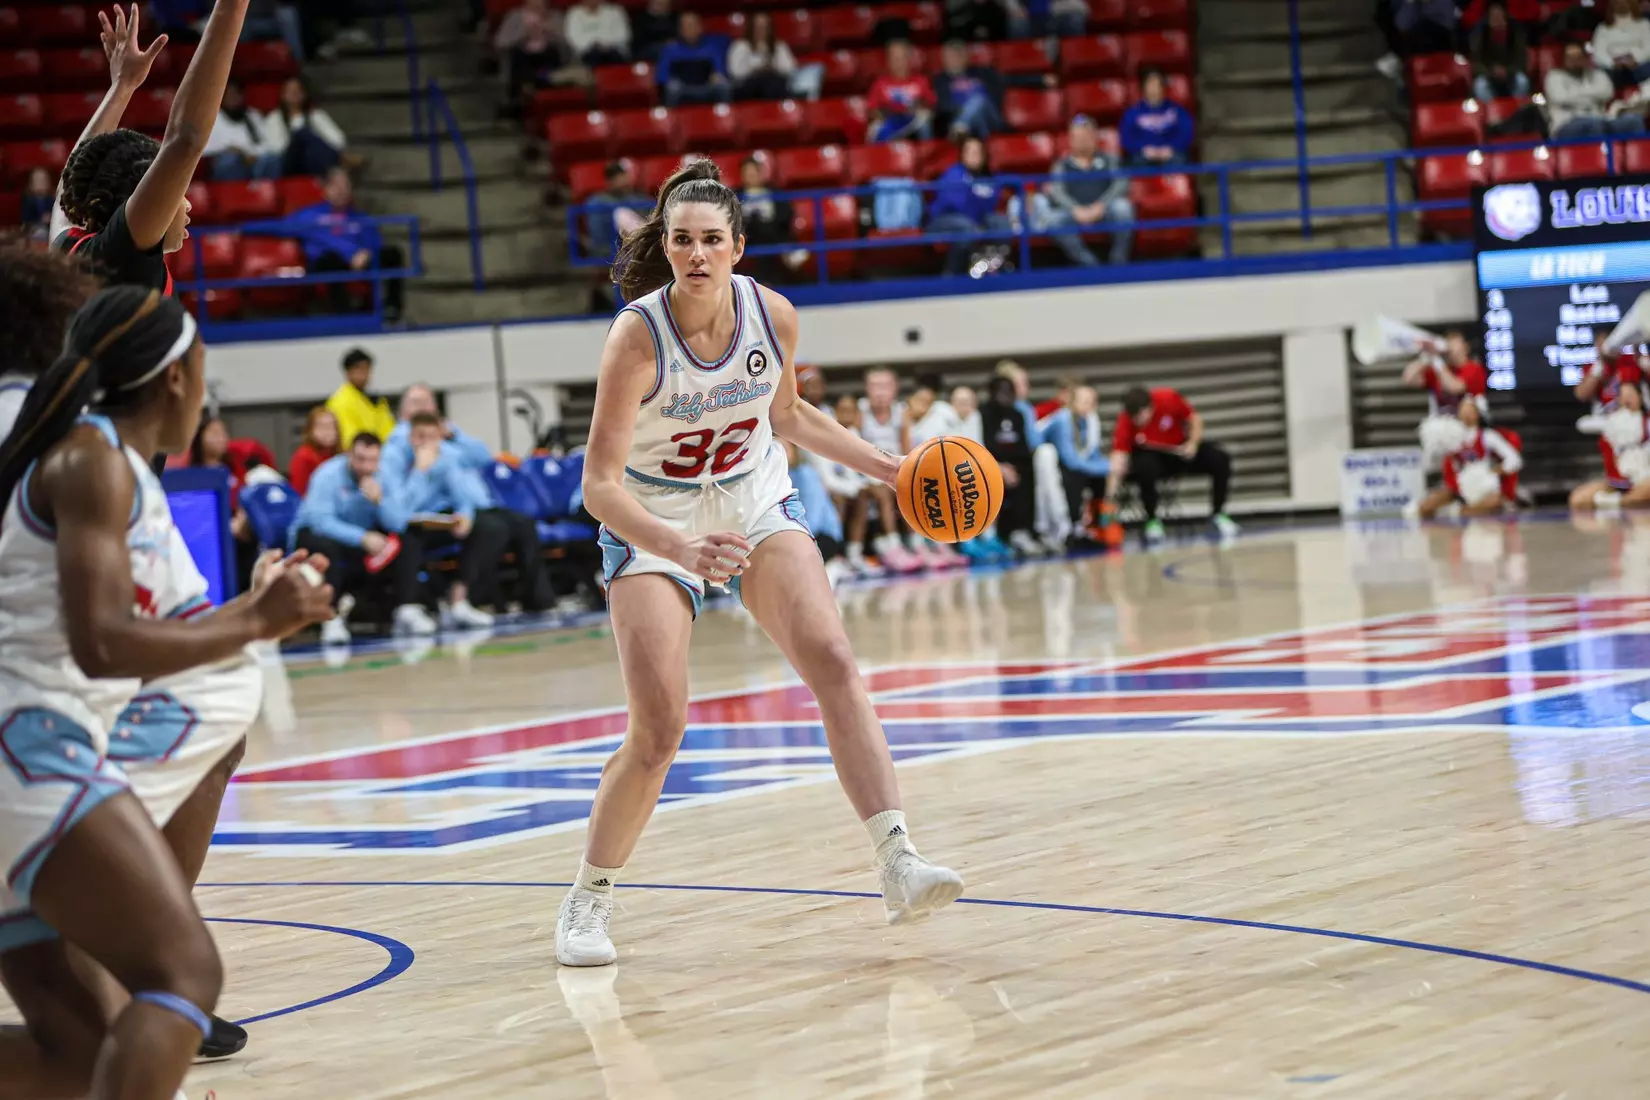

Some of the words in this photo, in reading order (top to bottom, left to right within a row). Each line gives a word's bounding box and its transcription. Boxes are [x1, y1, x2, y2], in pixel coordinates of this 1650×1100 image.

[661, 391, 705, 424] Lady
[705, 378, 772, 412] Techsters
[661, 417, 759, 479] 32
[923, 477, 946, 529] NCAA
[954, 460, 980, 531] Wilson
